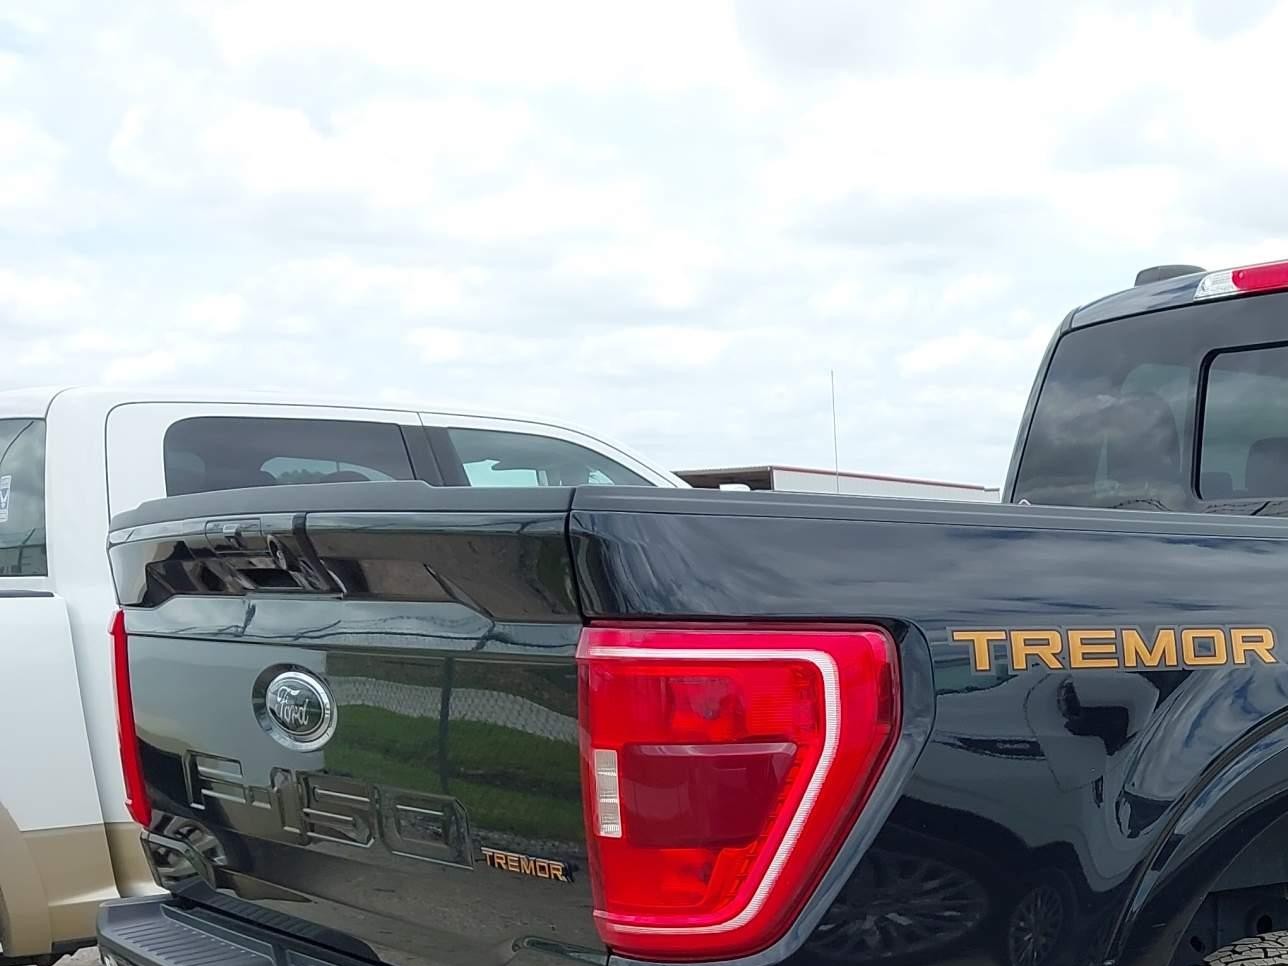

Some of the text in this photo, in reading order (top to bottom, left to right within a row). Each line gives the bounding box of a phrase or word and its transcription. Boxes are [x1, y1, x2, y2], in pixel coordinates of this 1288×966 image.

[951, 627, 1278, 672] TREMOR
[276, 686, 310, 726] Ford
[183, 749, 474, 872] F-150
[480, 846, 570, 882] TREMOR
